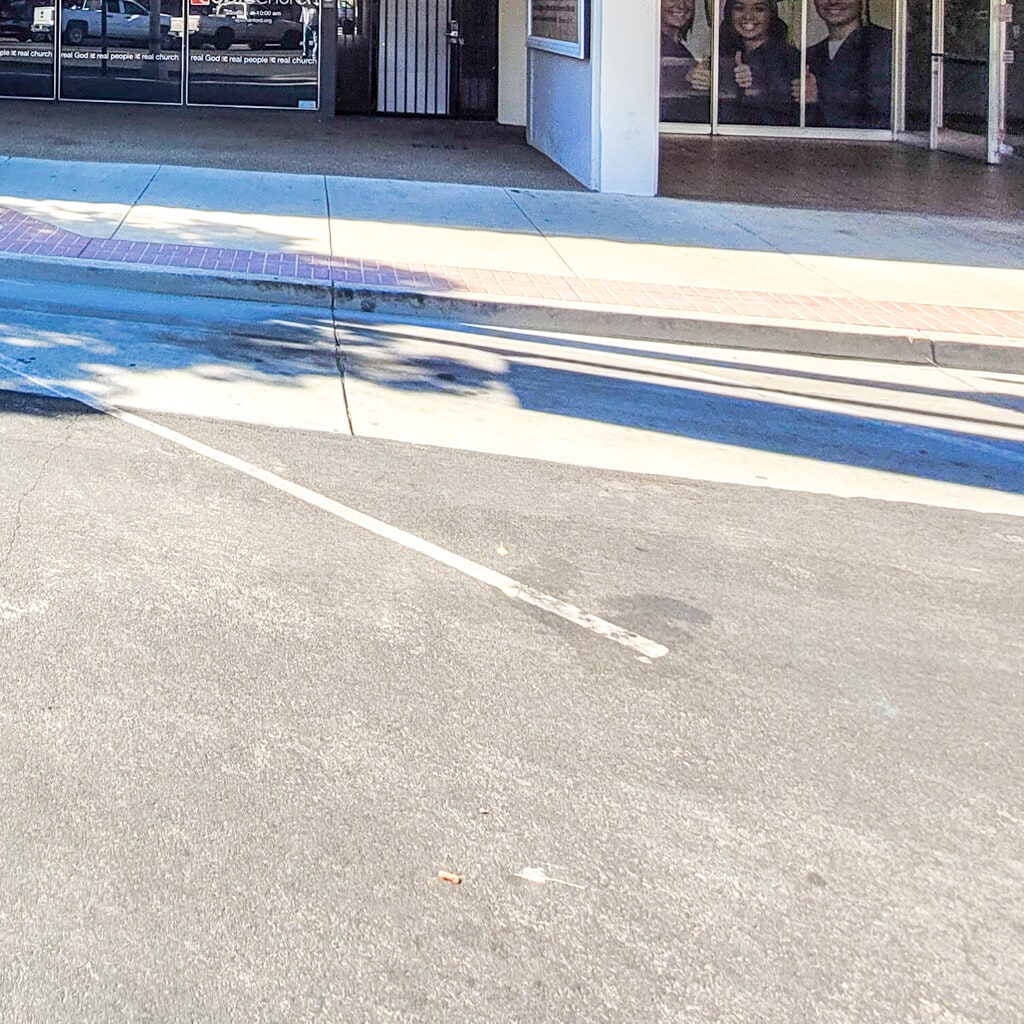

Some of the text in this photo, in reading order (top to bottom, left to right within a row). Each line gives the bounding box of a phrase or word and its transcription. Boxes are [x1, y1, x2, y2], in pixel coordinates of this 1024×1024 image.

[74, 51, 88, 59] God
[110, 53, 133, 61] people
[156, 53, 179, 61] church
[205, 54, 220, 62] God
[229, 55, 242, 63] real
[244, 56, 268, 64] people
